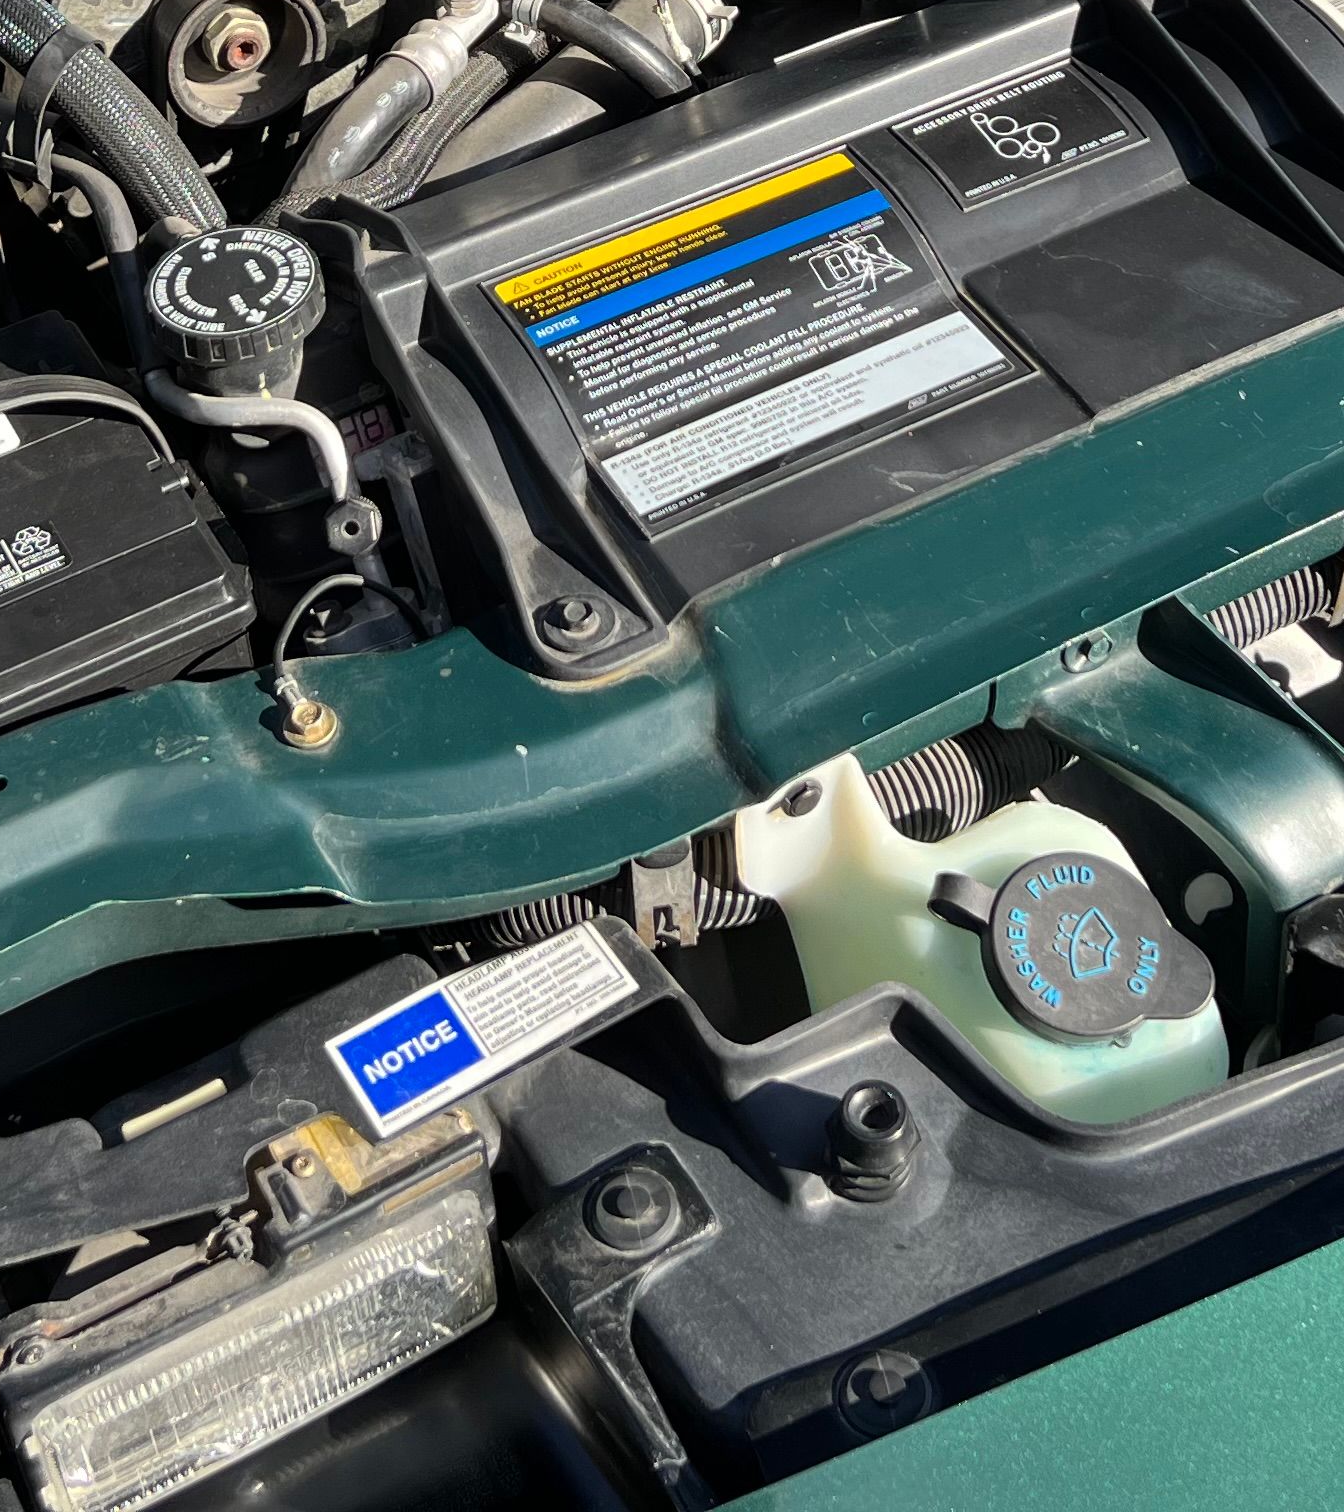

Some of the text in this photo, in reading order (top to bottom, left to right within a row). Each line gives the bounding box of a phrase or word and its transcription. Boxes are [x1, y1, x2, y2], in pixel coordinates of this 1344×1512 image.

[912, 71, 1066, 135] ACCESSORY DRIVE BELT ROUTING
[155, 253, 225, 332] ALIGN ARROW & VENT TUBE
[175, 266, 217, 317] CLOSED SYSTEM
[225, 242, 290, 306] CHECK LEVEL IN BOTTLE
[241, 230, 310, 306] NEVER OPEN HOT
[512, 223, 723, 308] FAN BLADE STARTS WITHOUT ENGINE RUNNING.
[531, 300, 546, 310] To
[544, 292, 566, 306] help
[564, 282, 591, 298] avoid
[590, 268, 630, 288] personal
[655, 248, 679, 263] keep
[677, 238, 706, 254] hands
[704, 229, 729, 244] clear.
[531, 261, 584, 286] CAUTION
[534, 315, 581, 338] NOTICE
[544, 278, 729, 356] SUPPLEMENTAL INFLATABLE RESTRAINT.
[564, 278, 756, 360] This vehicle is equipped with a supplemental
[570, 317, 688, 369] inflatable restraint system.
[576, 367, 592, 379] To
[588, 359, 612, 374] help
[609, 345, 646, 366] prevent
[643, 328, 690, 352] unwanted
[725, 306, 744, 320] see
[741, 299, 761, 313] GM
[758, 286, 793, 306] Service
[581, 304, 778, 389] Manual for diagnostic and service procedures
[582, 302, 867, 424] THIS VEHICLE REQUIRES A SPECIAL COOLANT FILL PROCEDURE.
[587, 339, 722, 400] before performing any service.
[601, 303, 895, 428] Read Owner's or Service Manual before adding any coolant to system.
[638, 415, 652, 426] to
[649, 403, 681, 422] follow
[678, 390, 713, 410] special
[709, 385, 724, 397] fill
[721, 367, 770, 392] procedure
[766, 356, 795, 373] could
[791, 346, 819, 363] result
[816, 342, 829, 353] in
[825, 330, 859, 349] serious
[855, 315, 895, 336] damage
[891, 311, 905, 321] to
[901, 305, 920, 317] the
[613, 429, 650, 449] engine.
[464, 967, 513, 1001] HEADLAMP
[514, 930, 579, 974] REPLACEMENT
[1007, 864, 1161, 1009] WASHER FLUID ONLY
[361, 1019, 458, 1084] NOTICE
